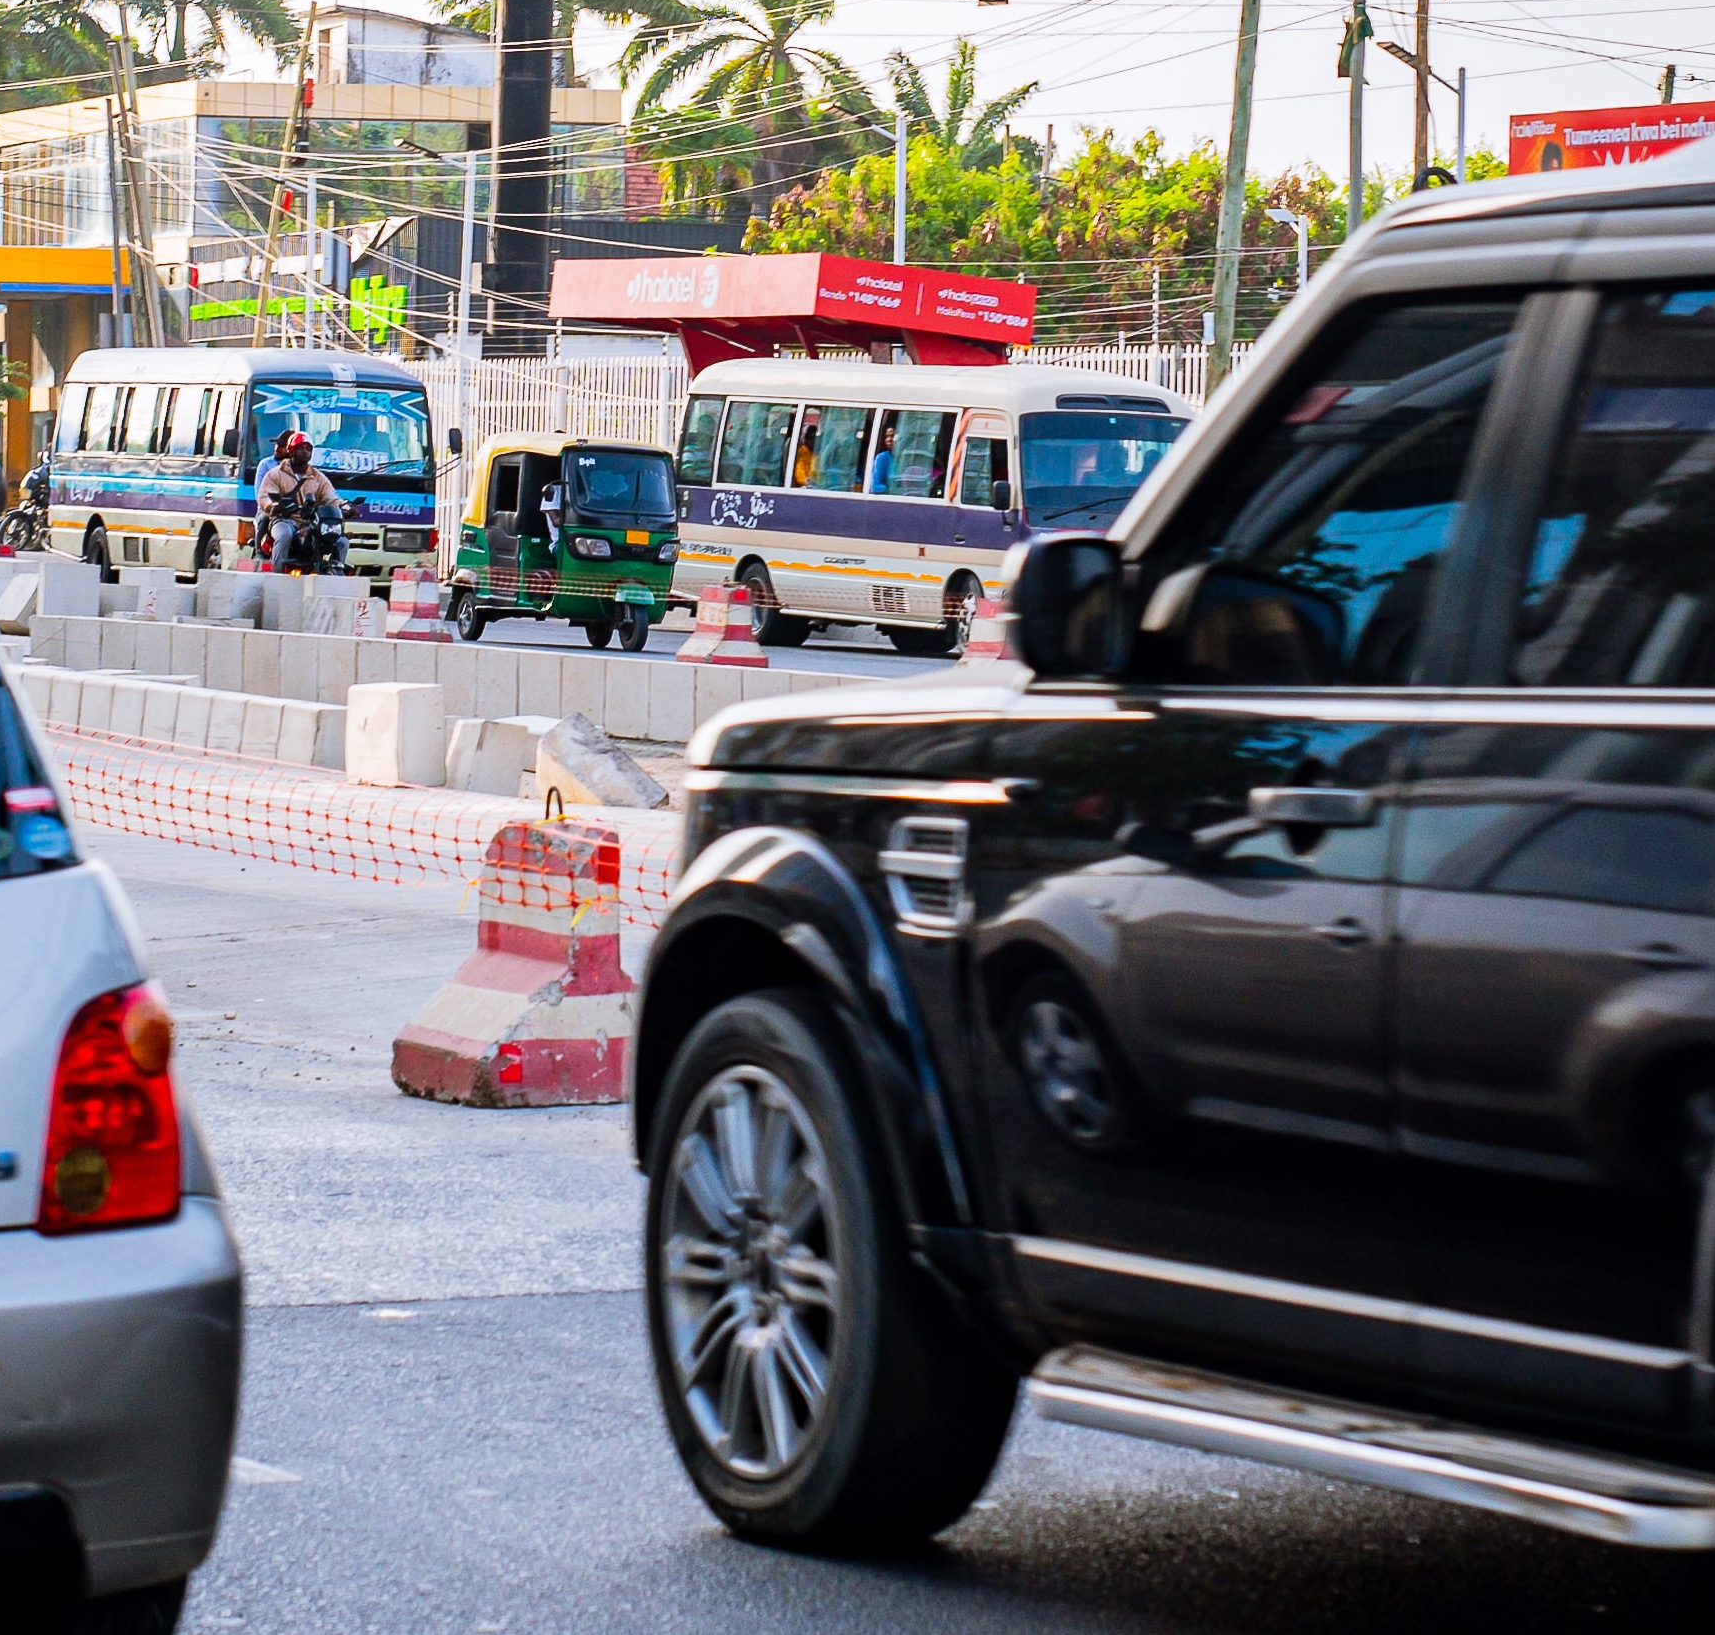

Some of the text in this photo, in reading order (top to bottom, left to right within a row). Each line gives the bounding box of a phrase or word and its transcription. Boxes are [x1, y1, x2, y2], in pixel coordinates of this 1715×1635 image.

[1563, 127, 1630, 147] Tumeenea
[1631, 122, 1658, 142] kwa
[1660, 121, 1682, 140] bei
[641, 268, 696, 303] halotel
